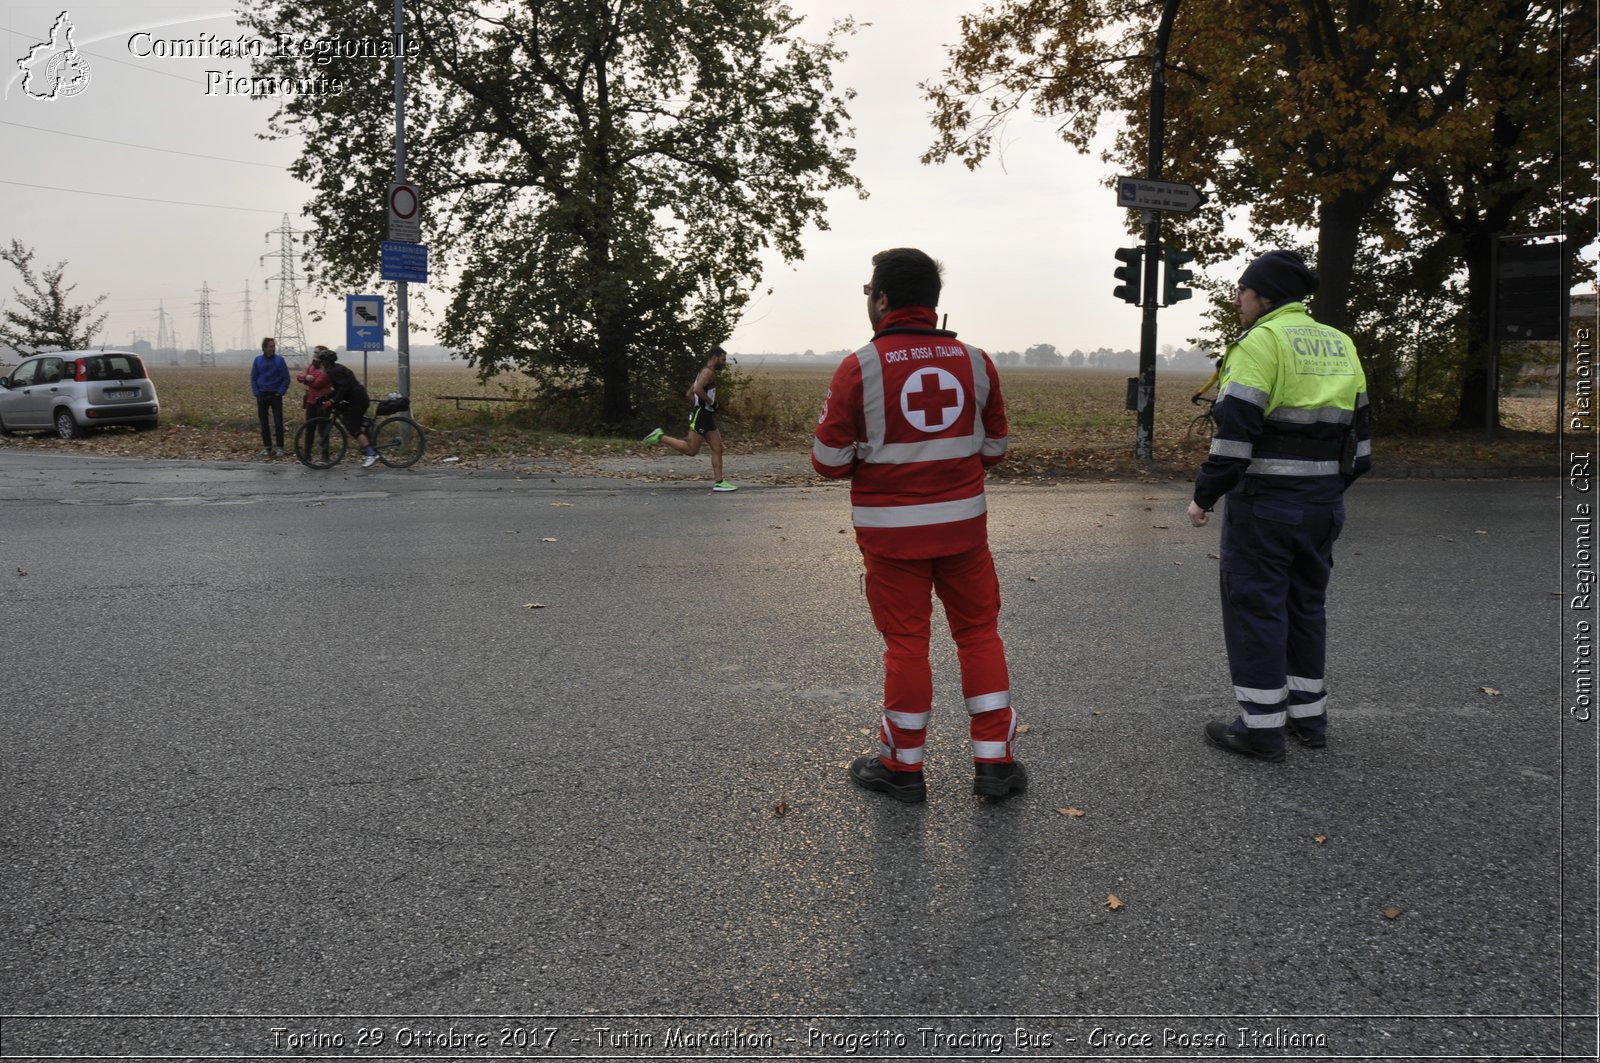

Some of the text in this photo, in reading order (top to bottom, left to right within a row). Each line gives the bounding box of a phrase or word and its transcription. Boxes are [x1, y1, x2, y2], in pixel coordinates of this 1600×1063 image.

[383, 244, 426, 255] CARABINIERI
[1286, 328, 1343, 339] PROTEZIONE
[363, 341, 381, 349] 2000
[1293, 337, 1346, 358] CIVILE
[885, 345, 965, 363] CROCE ROSSA ITALIANA
